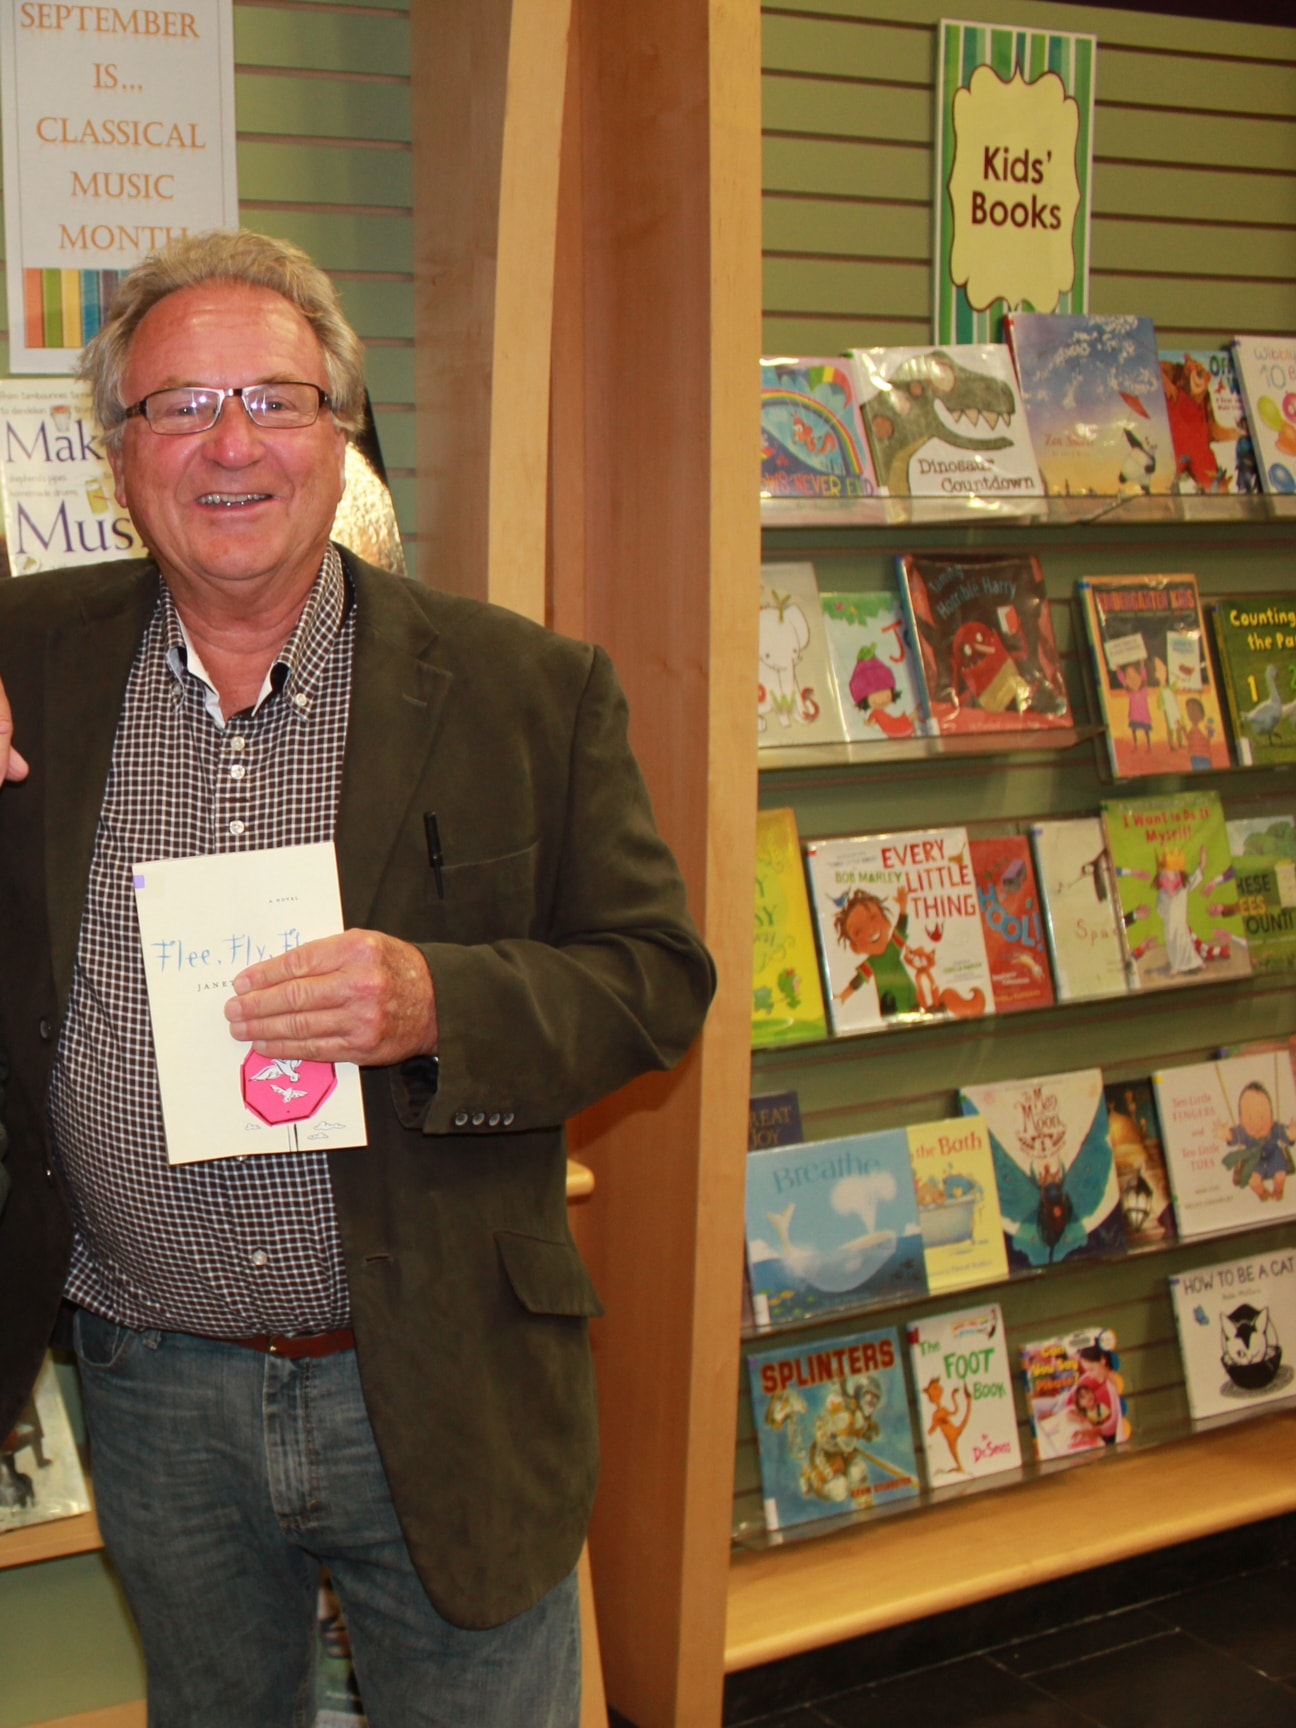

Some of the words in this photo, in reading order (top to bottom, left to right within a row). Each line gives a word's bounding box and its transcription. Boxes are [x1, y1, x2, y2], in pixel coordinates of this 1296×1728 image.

[20, 2, 200, 38] SEPTEMBER
[93, 62, 143, 91] IS...
[36, 116, 207, 149] CLASSICAL
[983, 146, 1052, 184] Kids'
[70, 170, 175, 201] MUSIC
[971, 191, 1061, 229] Books
[6, 419, 105, 462] Mak
[941, 476, 1034, 493] Countdown
[17, 500, 136, 553] Mus
[1230, 607, 1296, 629] Counting
[1247, 632, 1273, 651] the
[1276, 631, 1296, 650] Pa
[881, 839, 945, 870] EVERY
[834, 871, 856, 884] BOB
[859, 871, 903, 884] MARLEY
[905, 864, 972, 894] LITTLE
[910, 894, 977, 920] THING
[772, 1153, 881, 1194] Breathe
[1183, 1272, 1214, 1296] HOW
[1217, 1268, 1234, 1288] TO
[1237, 1265, 1255, 1284] BE
[1258, 1263, 1269, 1279] A
[1270, 1256, 1294, 1277] CAT
[761, 1339, 896, 1396] SPLINTERS
[943, 1348, 995, 1380] FOOT
